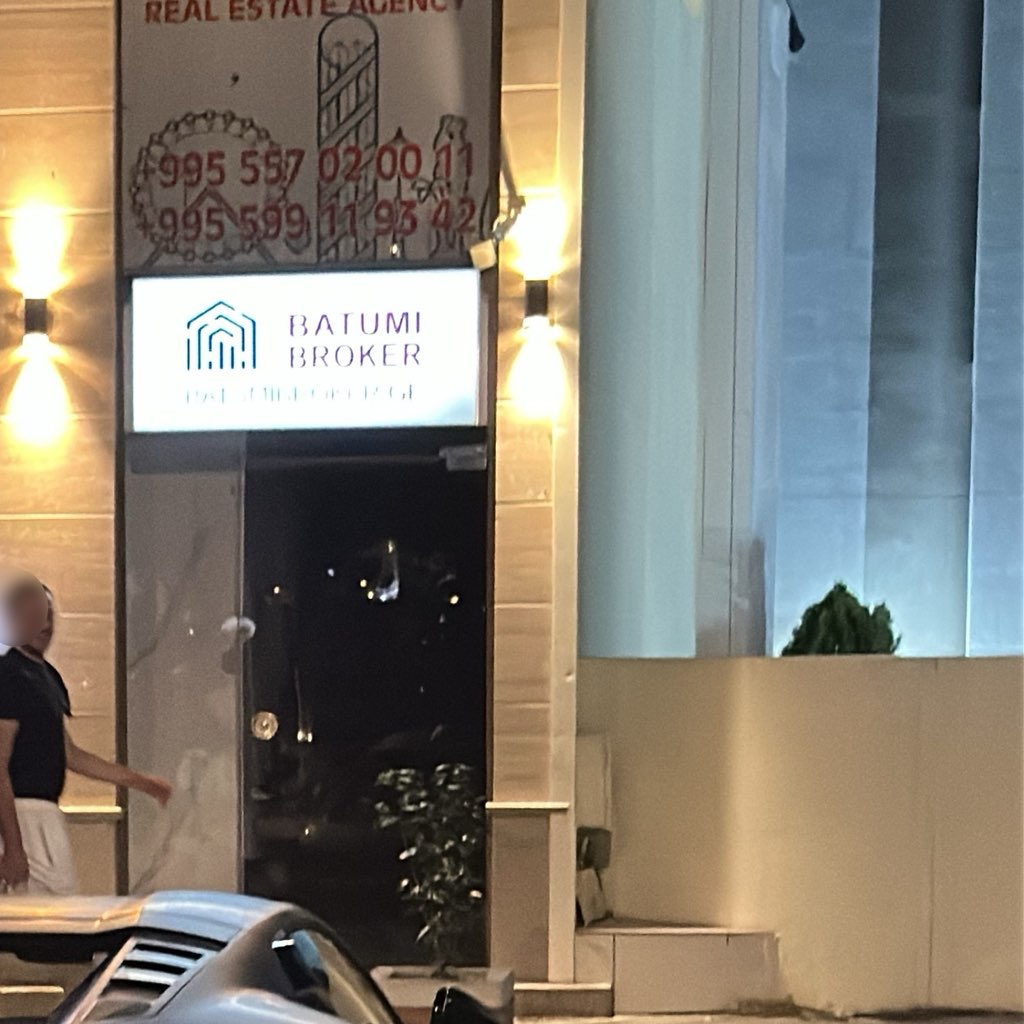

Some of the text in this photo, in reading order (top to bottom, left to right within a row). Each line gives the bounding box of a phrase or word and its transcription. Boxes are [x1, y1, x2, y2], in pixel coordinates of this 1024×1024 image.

[145, 0, 219, 24] REAL
[229, 0, 337, 21] ESTATE
[240, 148, 305, 186] 557
[318, 145, 362, 183] 02
[376, 143, 422, 181] 00
[435, 142, 473, 179] 11
[239, 203, 305, 240] 599
[320, 202, 357, 238] 11
[374, 199, 417, 236] 93
[432, 197, 476, 233] 42
[289, 311, 420, 337] BATUMI
[289, 343, 421, 369] BROKER
